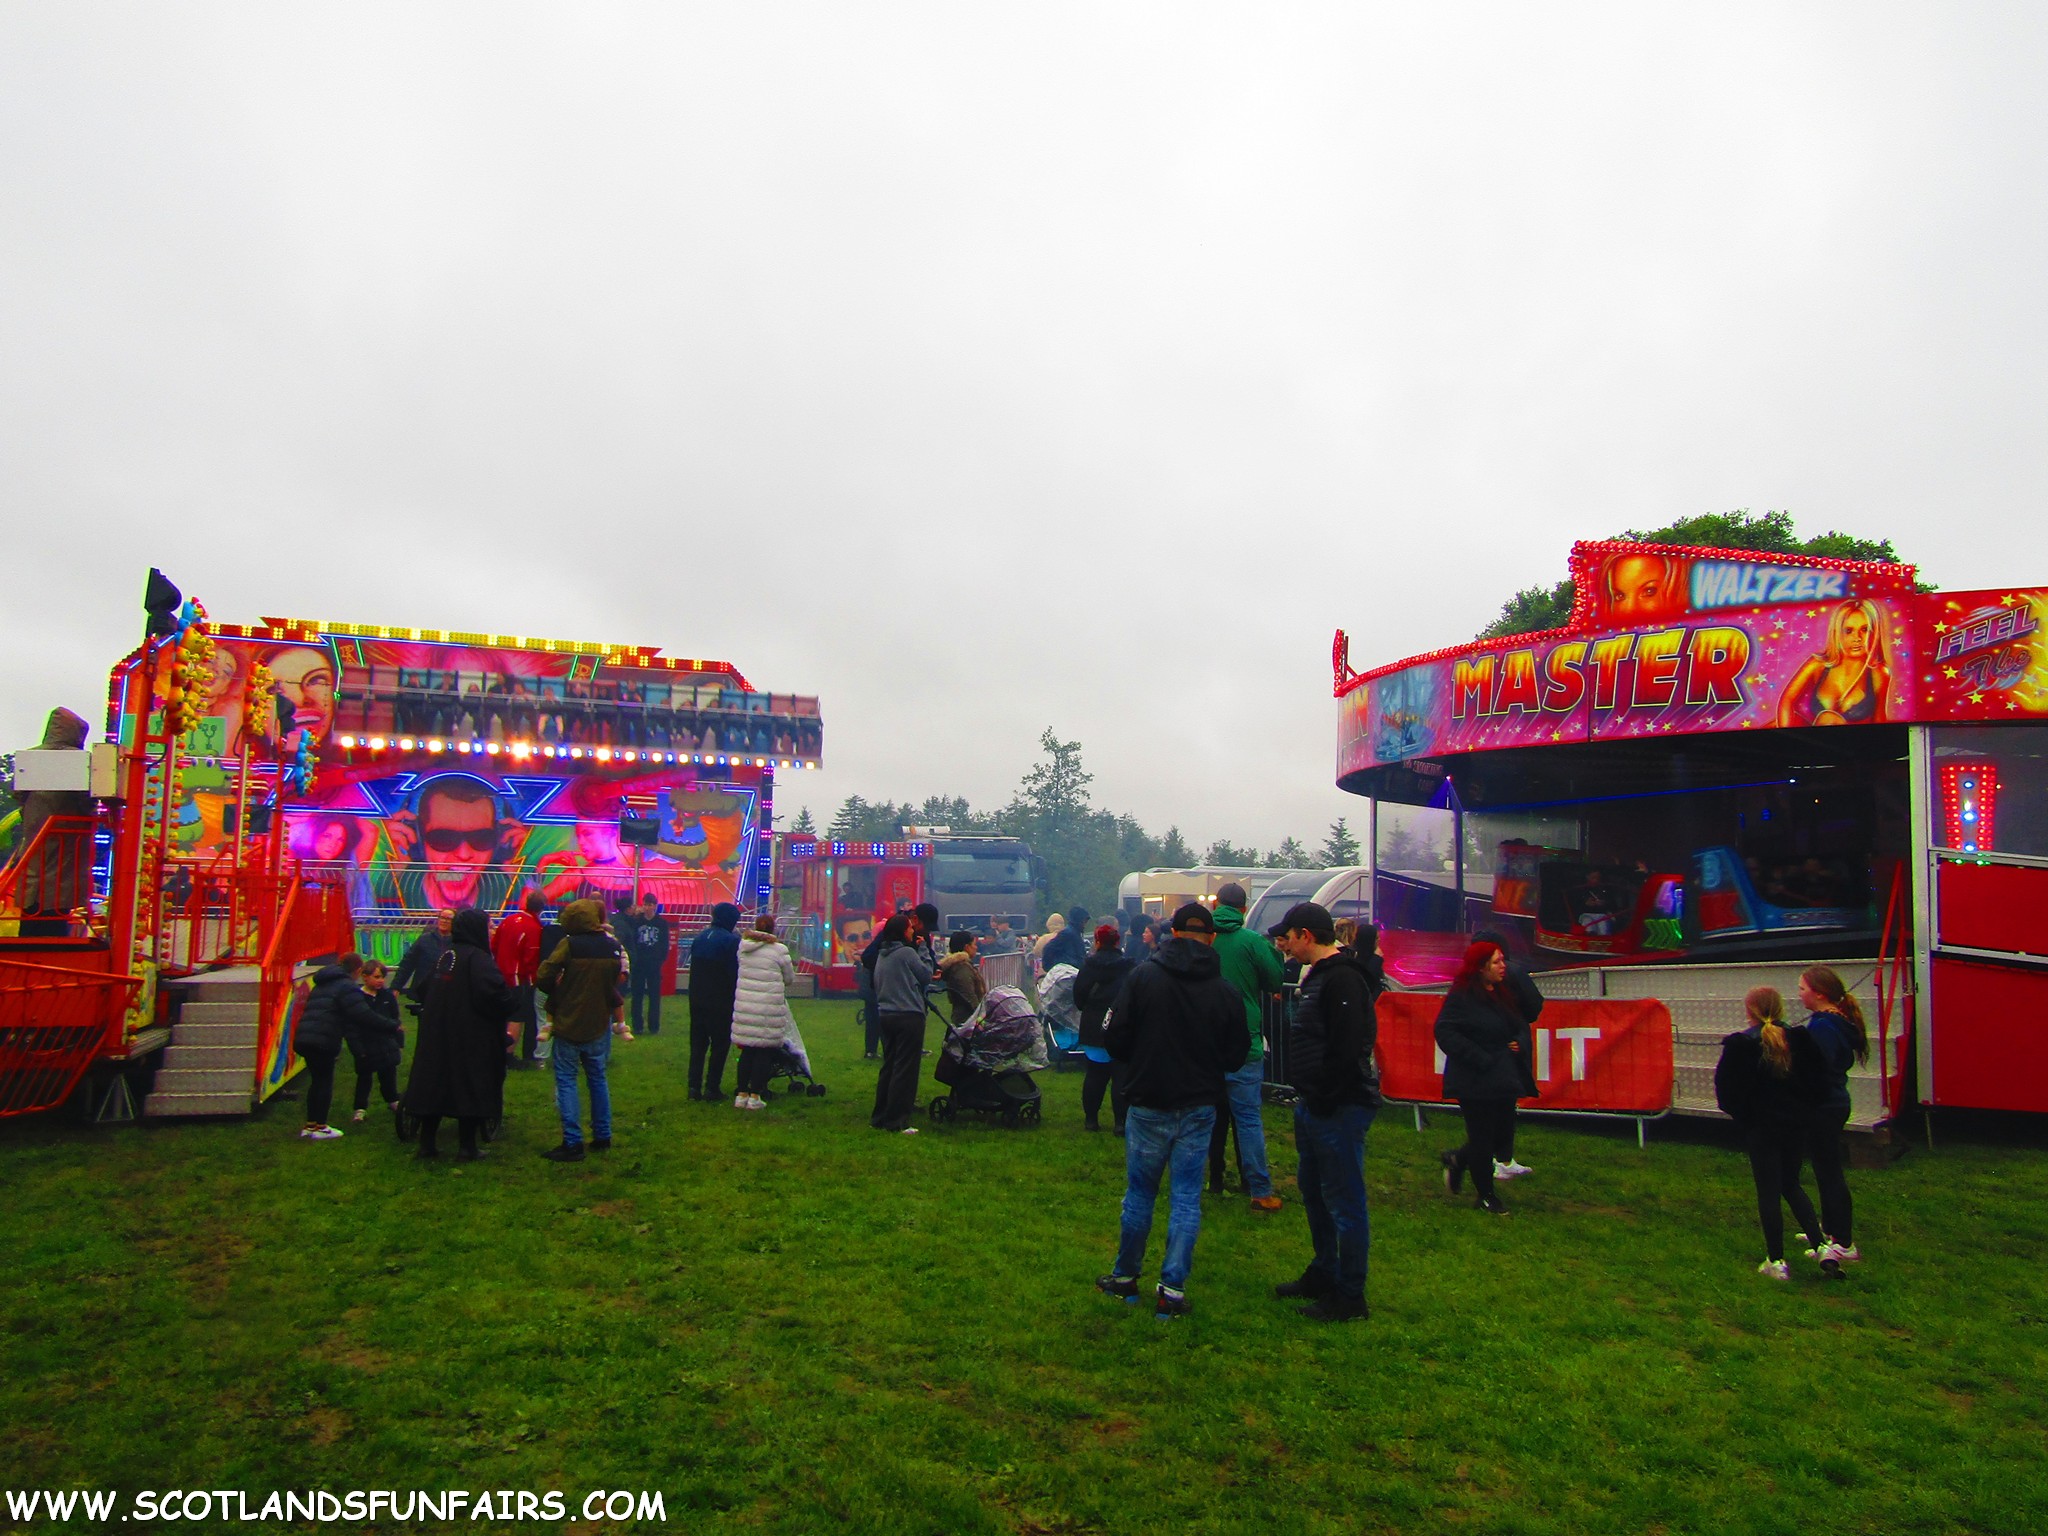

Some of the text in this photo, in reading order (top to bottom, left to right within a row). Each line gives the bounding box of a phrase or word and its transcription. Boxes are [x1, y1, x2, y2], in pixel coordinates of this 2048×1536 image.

[1693, 563, 1845, 609] WALTZER
[1935, 604, 2038, 663] FEEL
[1452, 626, 1750, 720] MASTER
[1962, 646, 2031, 689] The
[1434, 1027, 1601, 1082] IT
